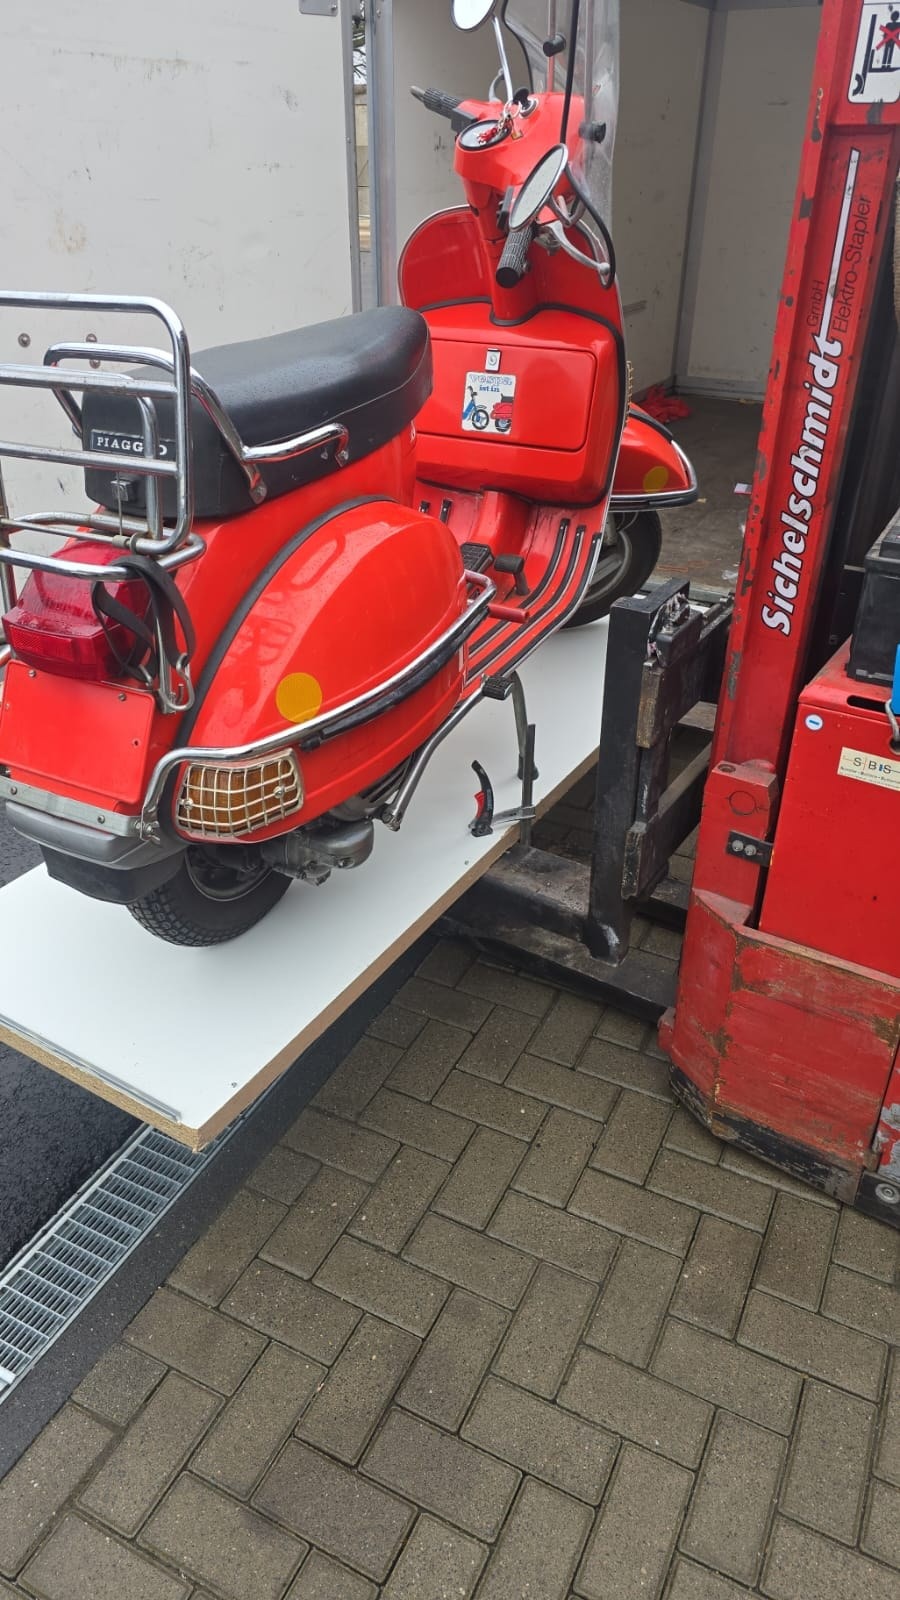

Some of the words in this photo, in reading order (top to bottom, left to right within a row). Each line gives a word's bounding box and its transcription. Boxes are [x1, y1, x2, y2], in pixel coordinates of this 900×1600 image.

[806, 280, 825, 327] GmbH
[832, 195, 872, 333] Elektro-Stapler
[96, 436, 168, 456] PIAGGO
[761, 333, 843, 636] Sichelschmidt
